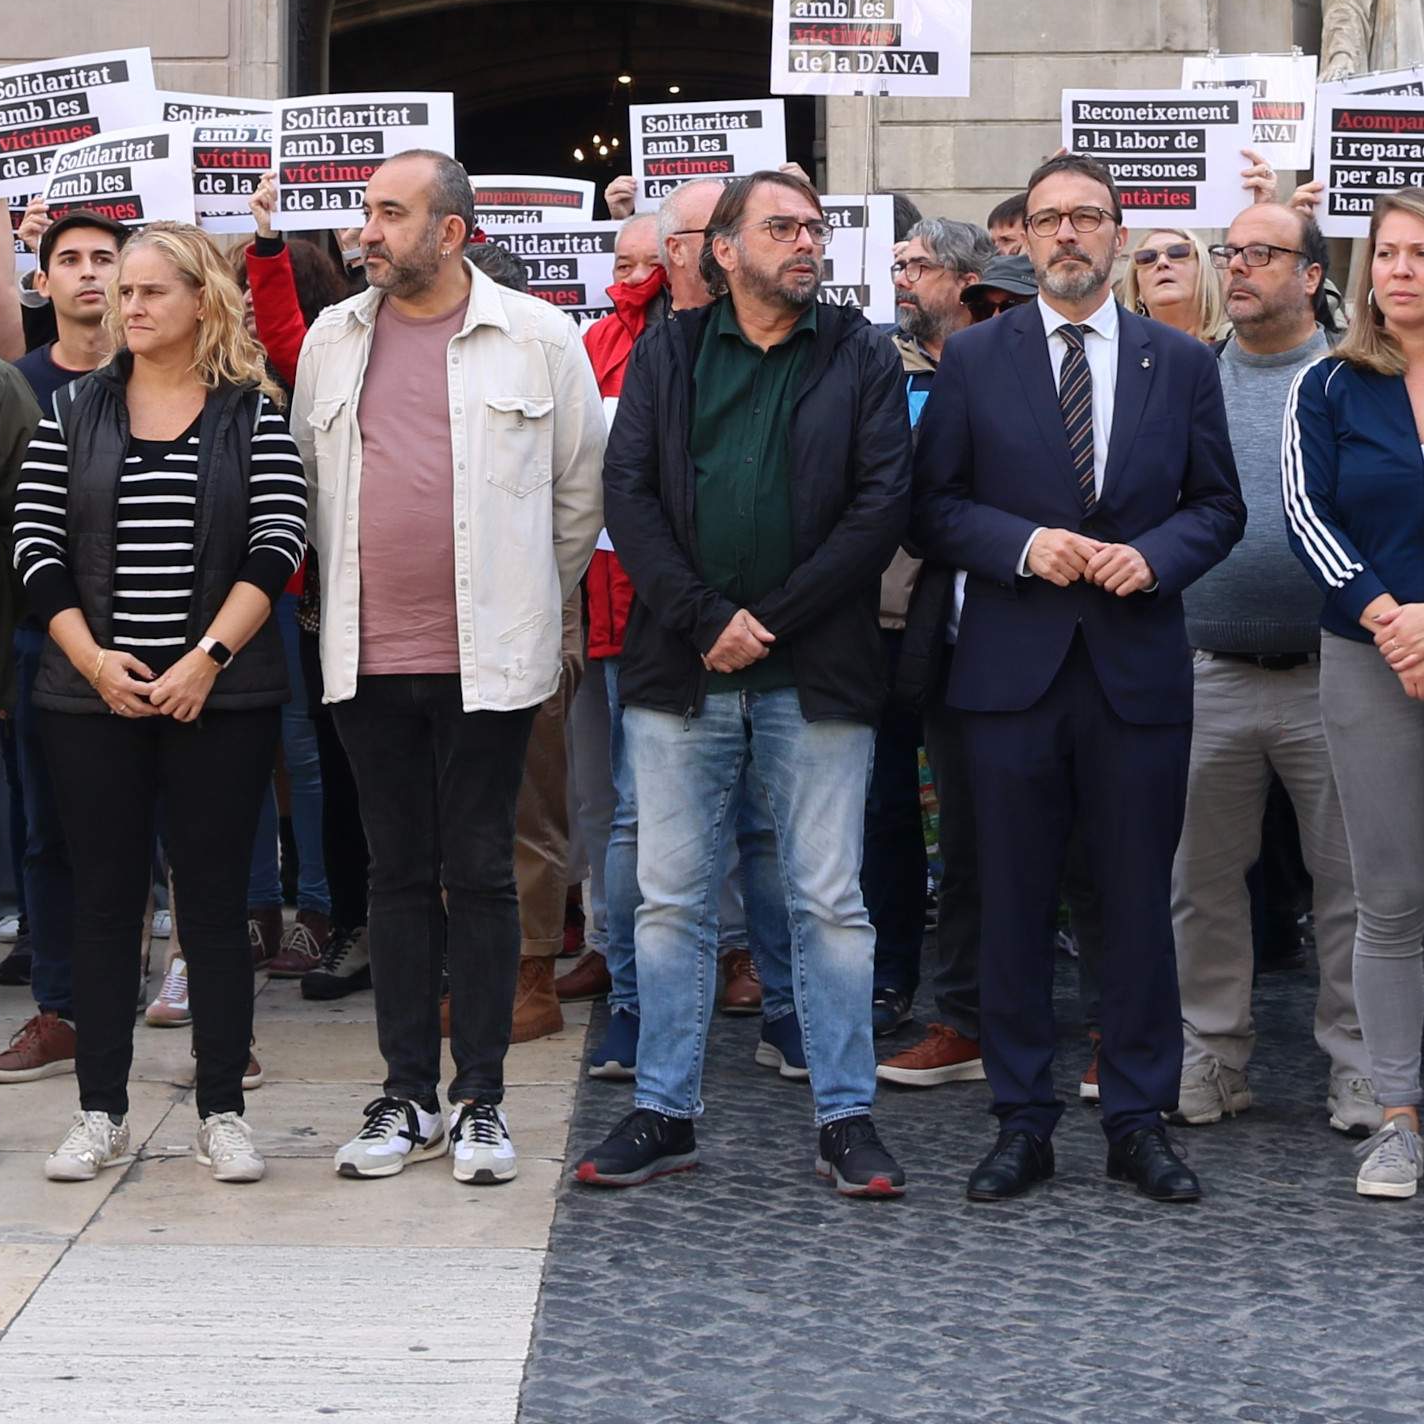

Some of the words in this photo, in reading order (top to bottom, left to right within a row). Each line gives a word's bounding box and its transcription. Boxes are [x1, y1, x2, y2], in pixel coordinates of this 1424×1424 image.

[793, 51, 822, 72] de
[829, 51, 851, 72] la
[857, 53, 929, 74] DANA
[50, 98, 81, 119] les
[285, 105, 411, 130] Solidaritat
[1077, 103, 1231, 121] Reconeixement
[644, 113, 749, 133] Solidaritat
[198, 127, 250, 142] amb
[1077, 136, 1089, 149] a
[1093, 132, 1113, 149] la
[1116, 132, 1168, 149] labor
[1173, 132, 1199, 149] de
[284, 135, 336, 156] amb
[342, 133, 375, 153] les
[646, 136, 689, 154] amb
[693, 135, 721, 152] les
[1335, 139, 1345, 157] i
[58, 142, 155, 173] Solidaritat
[647, 158, 730, 176] víctimes
[2, 159, 30, 178] de
[1108, 163, 1198, 180] persones
[1334, 169, 1372, 189] per
[1375, 167, 1405, 185] als
[49, 174, 92, 198] amb
[96, 172, 125, 192] les
[199, 175, 227, 194] de
[232, 174, 253, 194] la
[648, 181, 670, 198] de
[285, 190, 315, 210] de
[319, 189, 343, 209] la
[1333, 194, 1374, 212] han
[539, 261, 570, 280] les
